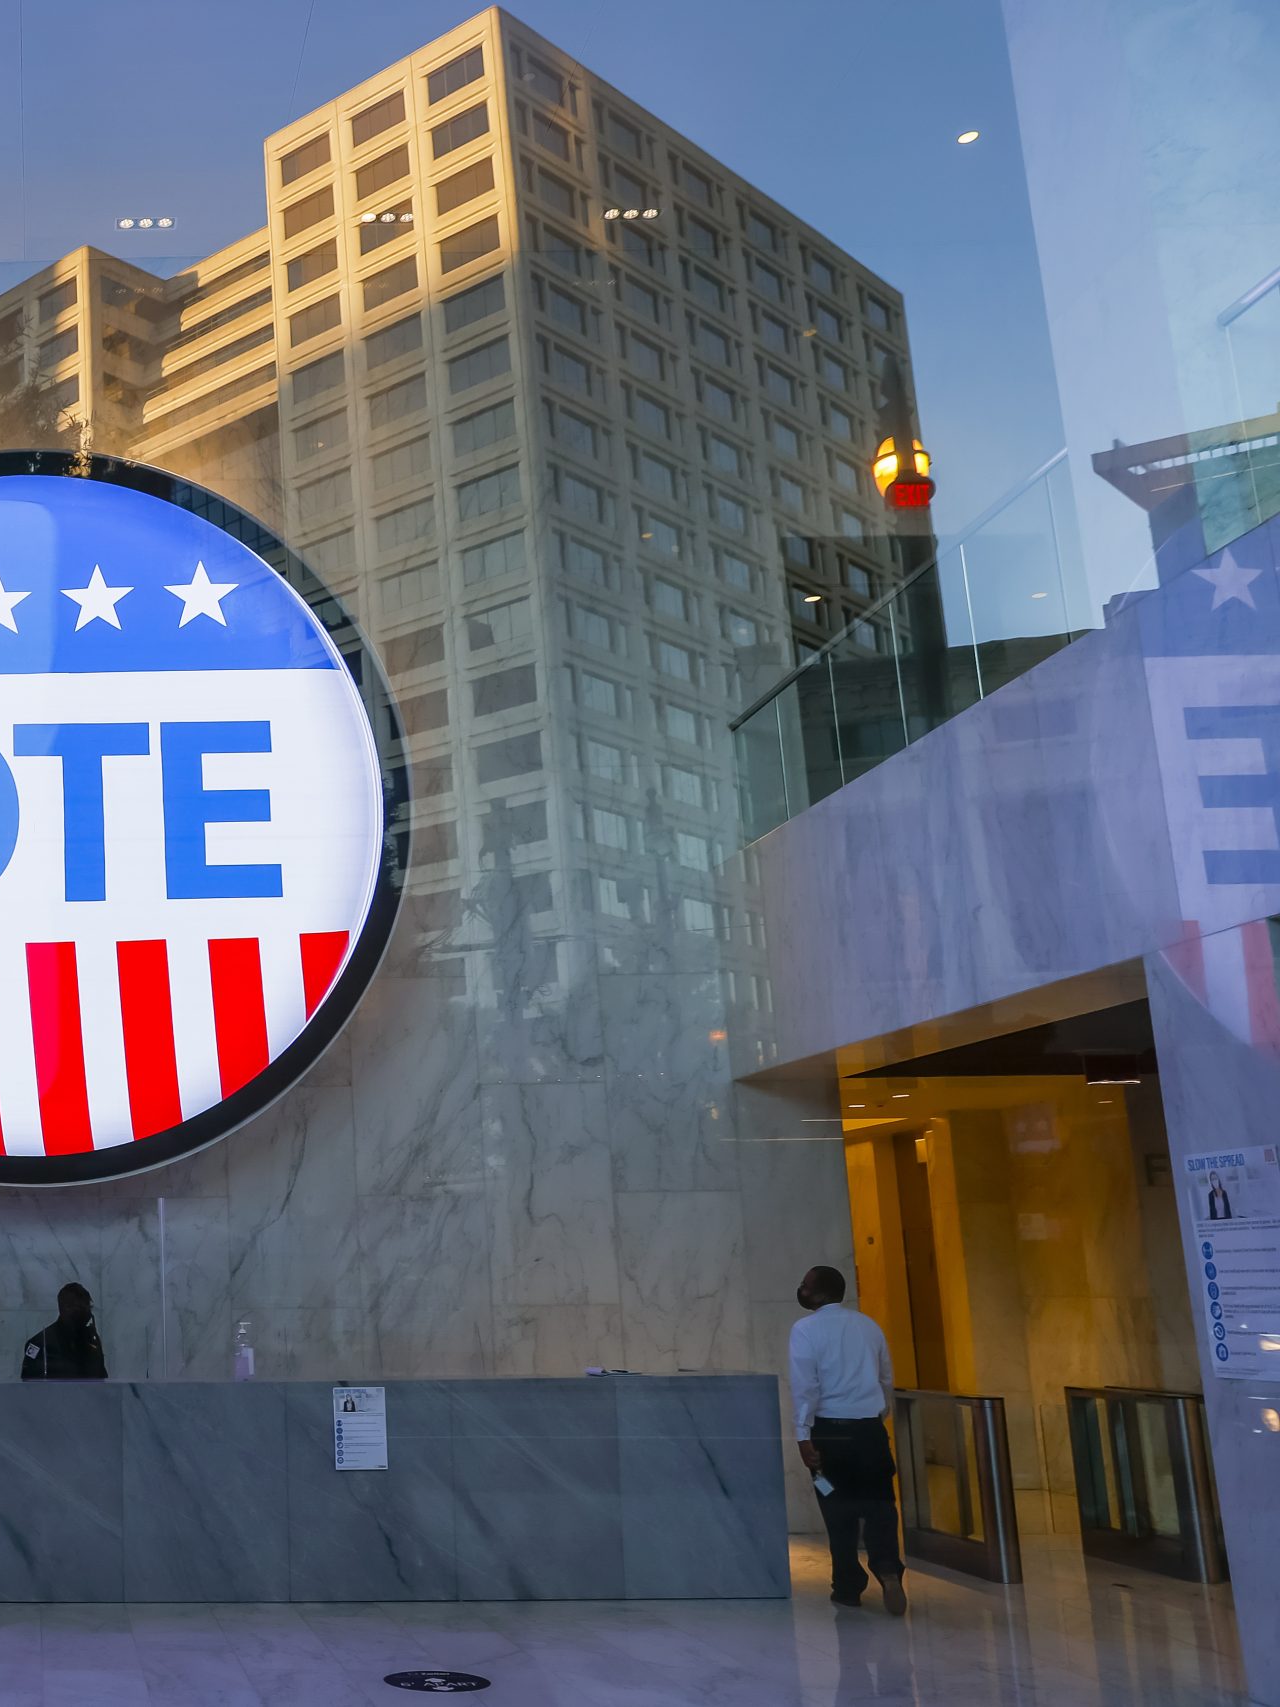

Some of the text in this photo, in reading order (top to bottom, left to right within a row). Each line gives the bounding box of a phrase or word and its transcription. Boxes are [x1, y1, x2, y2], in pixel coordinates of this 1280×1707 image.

[1187, 1158, 1206, 1172] SLOW
[1206, 1156, 1219, 1169] THE
[1219, 1153, 1245, 1168] SPREAD
